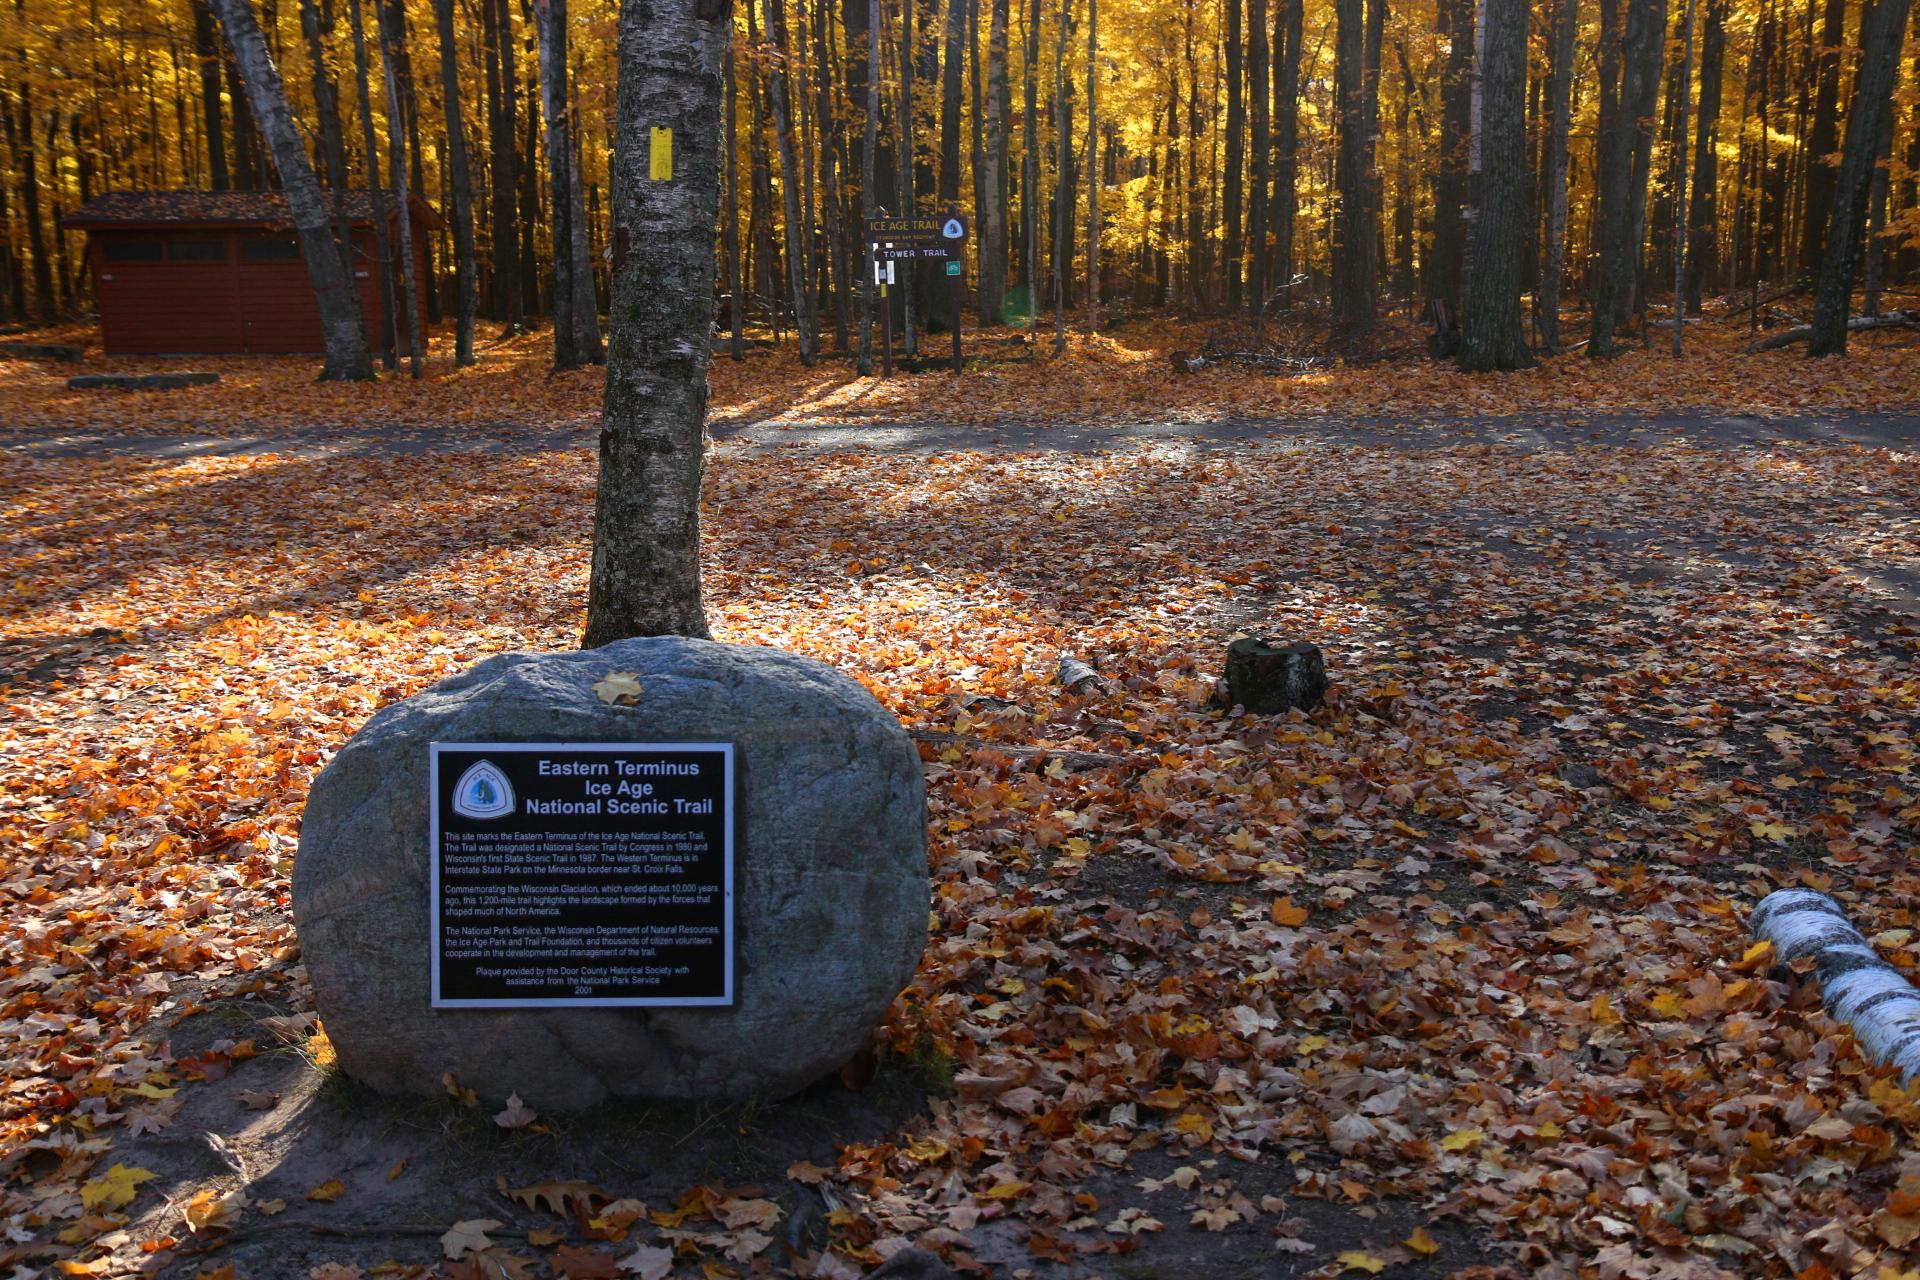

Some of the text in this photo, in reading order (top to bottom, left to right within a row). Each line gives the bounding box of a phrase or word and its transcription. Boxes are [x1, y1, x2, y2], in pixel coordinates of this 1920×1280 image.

[870, 220, 940, 231] ICE AGE TRAIL
[884, 249, 948, 258] TOWER TRAIL
[539, 761, 700, 776] Eastern Terminus
[586, 780, 653, 799] Ice Age
[526, 798, 712, 814] National Scenic Trail
[445, 832, 460, 840] This
[462, 832, 475, 840] site
[476, 831, 499, 840] marks
[500, 831, 513, 840] the
[514, 831, 543, 840] Eastern
[544, 831, 578, 840] Terminus
[579, 831, 587, 840] of
[588, 831, 600, 840] the
[601, 831, 613, 840] Ice
[614, 831, 630, 842] Age
[631, 831, 660, 840] National
[662, 831, 686, 840] Scenic
[445, 842, 460, 851] The
[462, 842, 477, 851] Trail
[494, 842, 535, 853] designated
[543, 842, 574, 851] National
[575, 842, 600, 850] Scenic
[602, 842, 617, 850] Trail
[618, 842, 628, 853] by
[629, 842, 665, 853] Congress
[666, 842, 672, 850] in
[694, 842, 708, 850] and
[488, 853, 503, 862] first
[504, 853, 524, 862] State
[526, 853, 550, 862] Scenic
[552, 853, 568, 862] Trail
[570, 853, 577, 862] in
[601, 853, 615, 862] The
[617, 853, 648, 862] Western
[649, 853, 682, 862] Terminus
[684, 853, 690, 862] is
[692, 853, 698, 862] in
[445, 865, 480, 873] Interstate
[482, 865, 502, 873] State
[503, 865, 521, 873] Park
[534, 865, 546, 873] the
[548, 865, 586, 873] Minnesota
[587, 864, 612, 873] border
[644, 864, 663, 873] Croix
[446, 884, 506, 895] Commemorating
[507, 884, 520, 893] the
[521, 884, 559, 893] Wisconsin
[602, 884, 622, 892] which
[624, 884, 648, 892] ended
[648, 884, 670, 892] about
[699, 885, 718, 894] years
[445, 897, 462, 906] ago,
[463, 895, 476, 904] this
[518, 895, 532, 904] trail
[533, 895, 567, 906] highlights
[568, 895, 580, 904] the
[582, 895, 620, 906] landscape
[620, 895, 646, 903] formed
[648, 895, 657, 906] by
[658, 895, 671, 903] the
[672, 895, 695, 903] forces
[696, 894, 710, 903] that
[446, 907, 473, 918] shaped
[474, 907, 495, 915] much
[496, 907, 504, 915] of
[505, 907, 527, 915] North
[446, 926, 460, 934] The
[461, 926, 492, 934] National
[493, 926, 510, 934] Park
[544, 926, 556, 934] the
[558, 926, 595, 934] Wisconsin
[596, 925, 640, 936] Department
[642, 925, 649, 934] of
[650, 925, 676, 934] Natural
[445, 936, 712, 948] the Ice Age Park and Trail Foundation, and thousands of citizen volunteers
[445, 948, 482, 959] cooperate
[483, 948, 490, 956] in
[492, 948, 504, 956] the
[505, 948, 553, 959] development
[554, 948, 569, 956] and
[570, 948, 618, 958] management
[620, 947, 626, 956] of
[628, 947, 640, 956] the
[476, 966, 689, 977] Plaque provided by the Door County Historical Society with
[506, 975, 660, 985] assistance from the National Park Service
[575, 985, 592, 994] 2001
